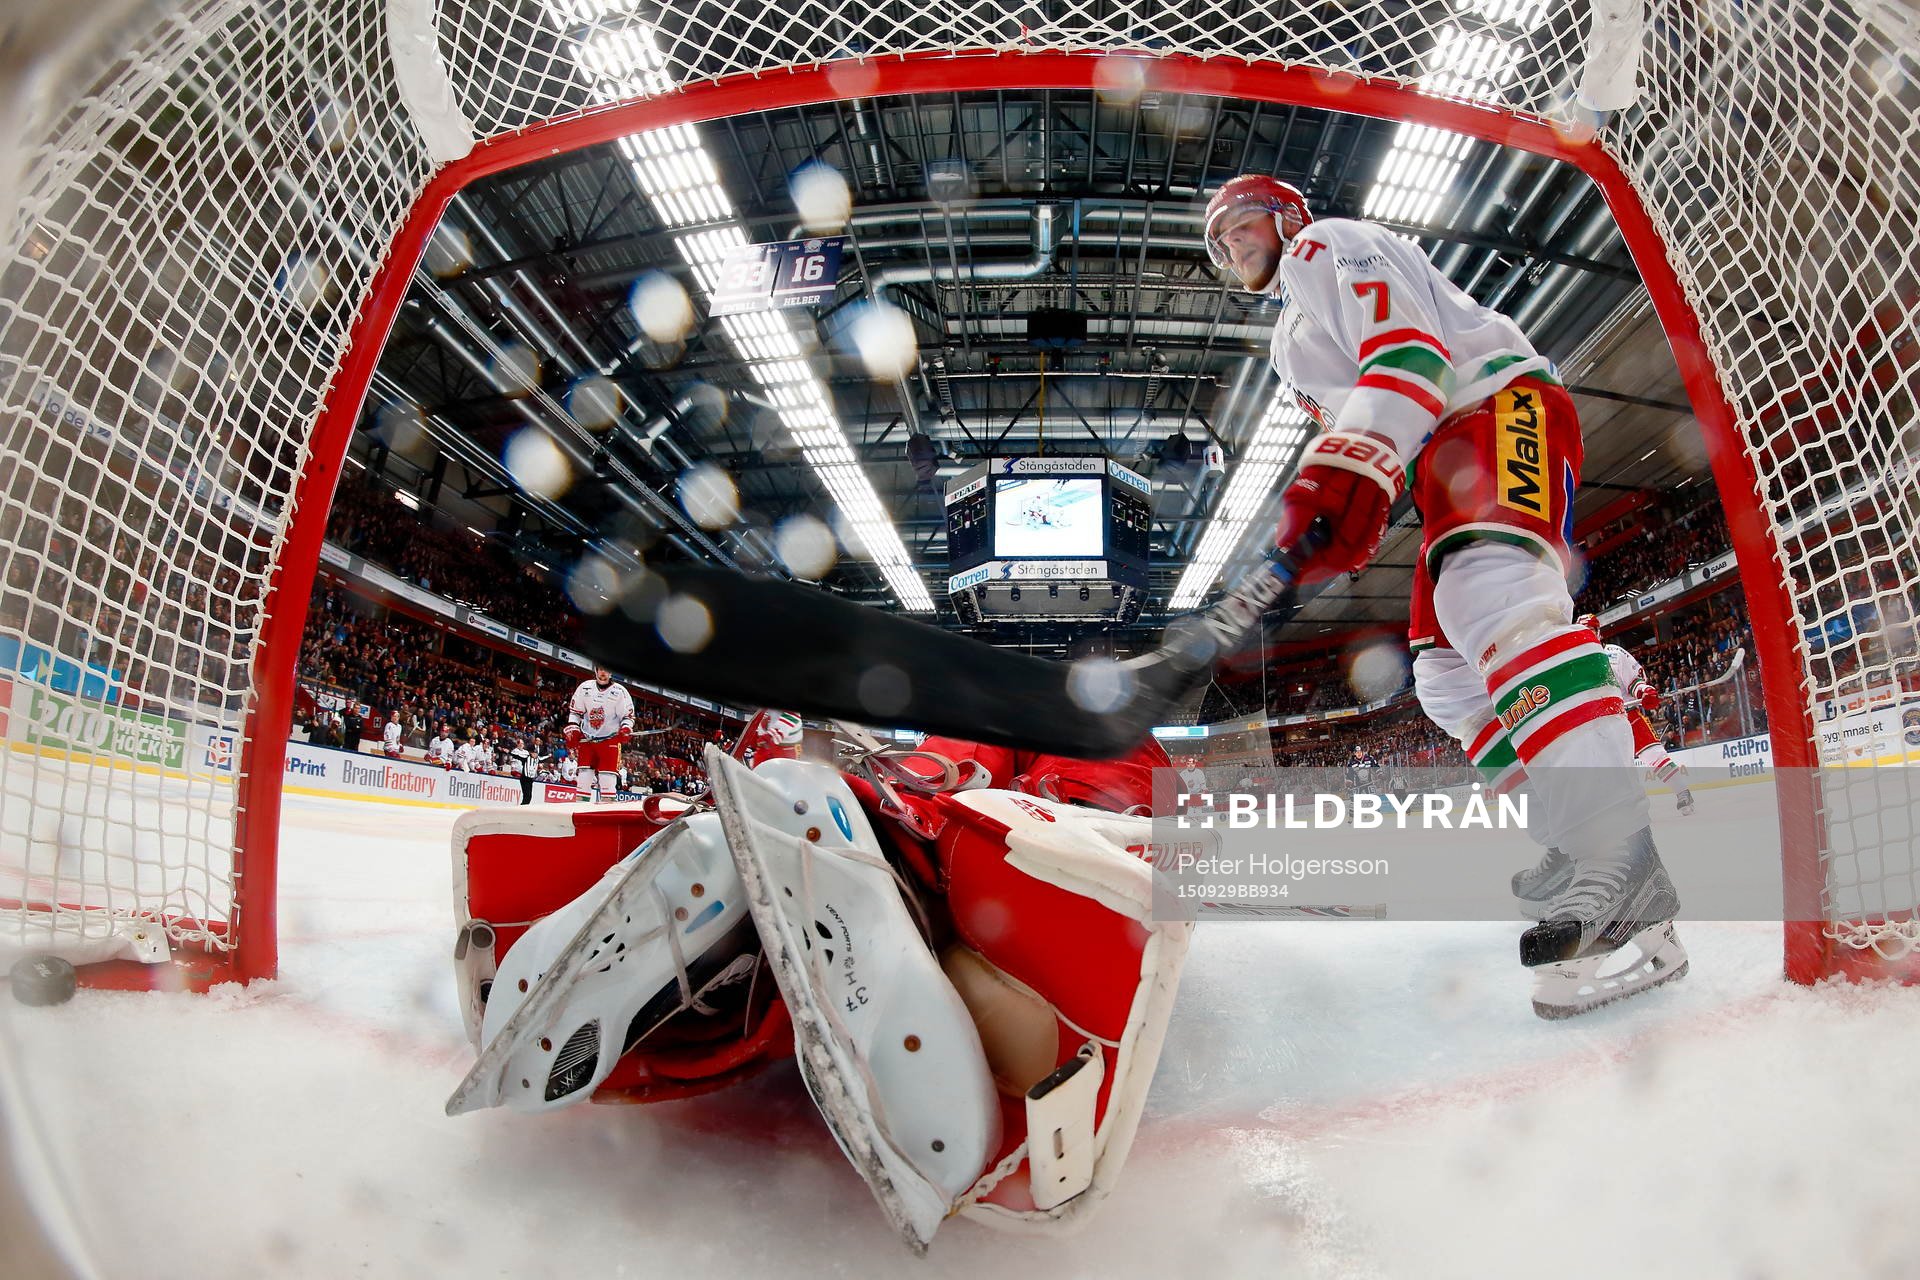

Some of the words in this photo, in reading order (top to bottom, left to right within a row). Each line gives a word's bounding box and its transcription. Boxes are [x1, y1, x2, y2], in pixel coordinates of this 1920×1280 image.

[792, 255, 826, 283] 16
[783, 294, 821, 306] HELBER
[1351, 281, 1391, 324] 7
[1505, 390, 1541, 512] Malux
[1018, 460, 1096, 473] Stångåstaden
[1110, 461, 1150, 494] Corren
[950, 567, 990, 591] Corren
[1017, 563, 1099, 577] Stångåstaden
[1711, 561, 1728, 574] SAAB
[31, 700, 110, 748] 200
[1722, 738, 1769, 760] ActiPro
[342, 759, 437, 798] BrandFactory
[1729, 758, 1765, 778] Event
[449, 775, 521, 806] BrandFactory
[547, 788, 576, 801] CCM
[825, 904, 845, 925] VENT
